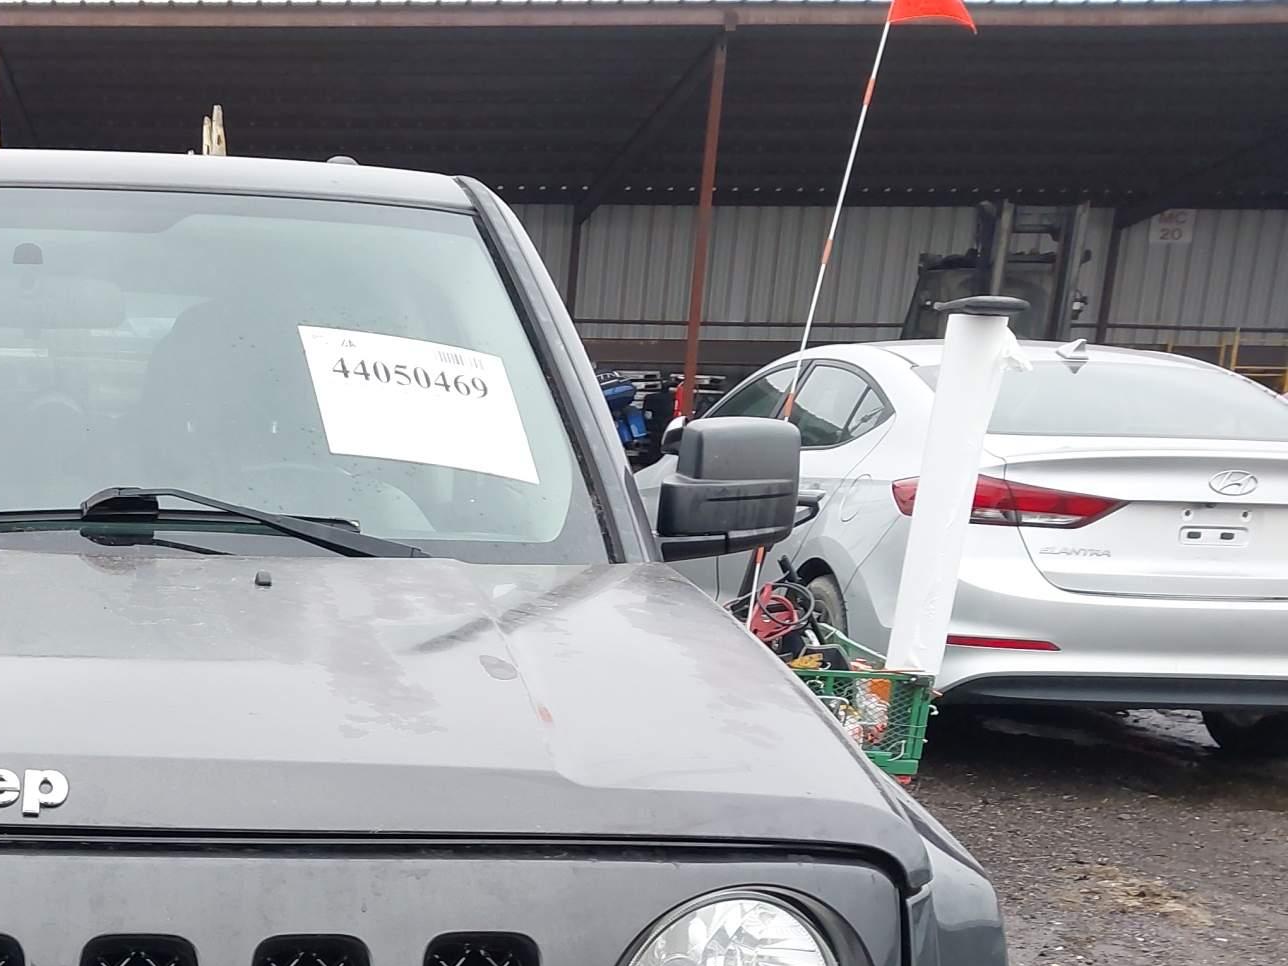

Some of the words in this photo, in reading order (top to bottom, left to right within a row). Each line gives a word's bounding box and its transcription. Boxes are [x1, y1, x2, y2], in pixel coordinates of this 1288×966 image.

[1159, 228, 1183, 241] 20
[332, 357, 489, 398] 44050469
[1039, 546, 1111, 558] ELANTRA
